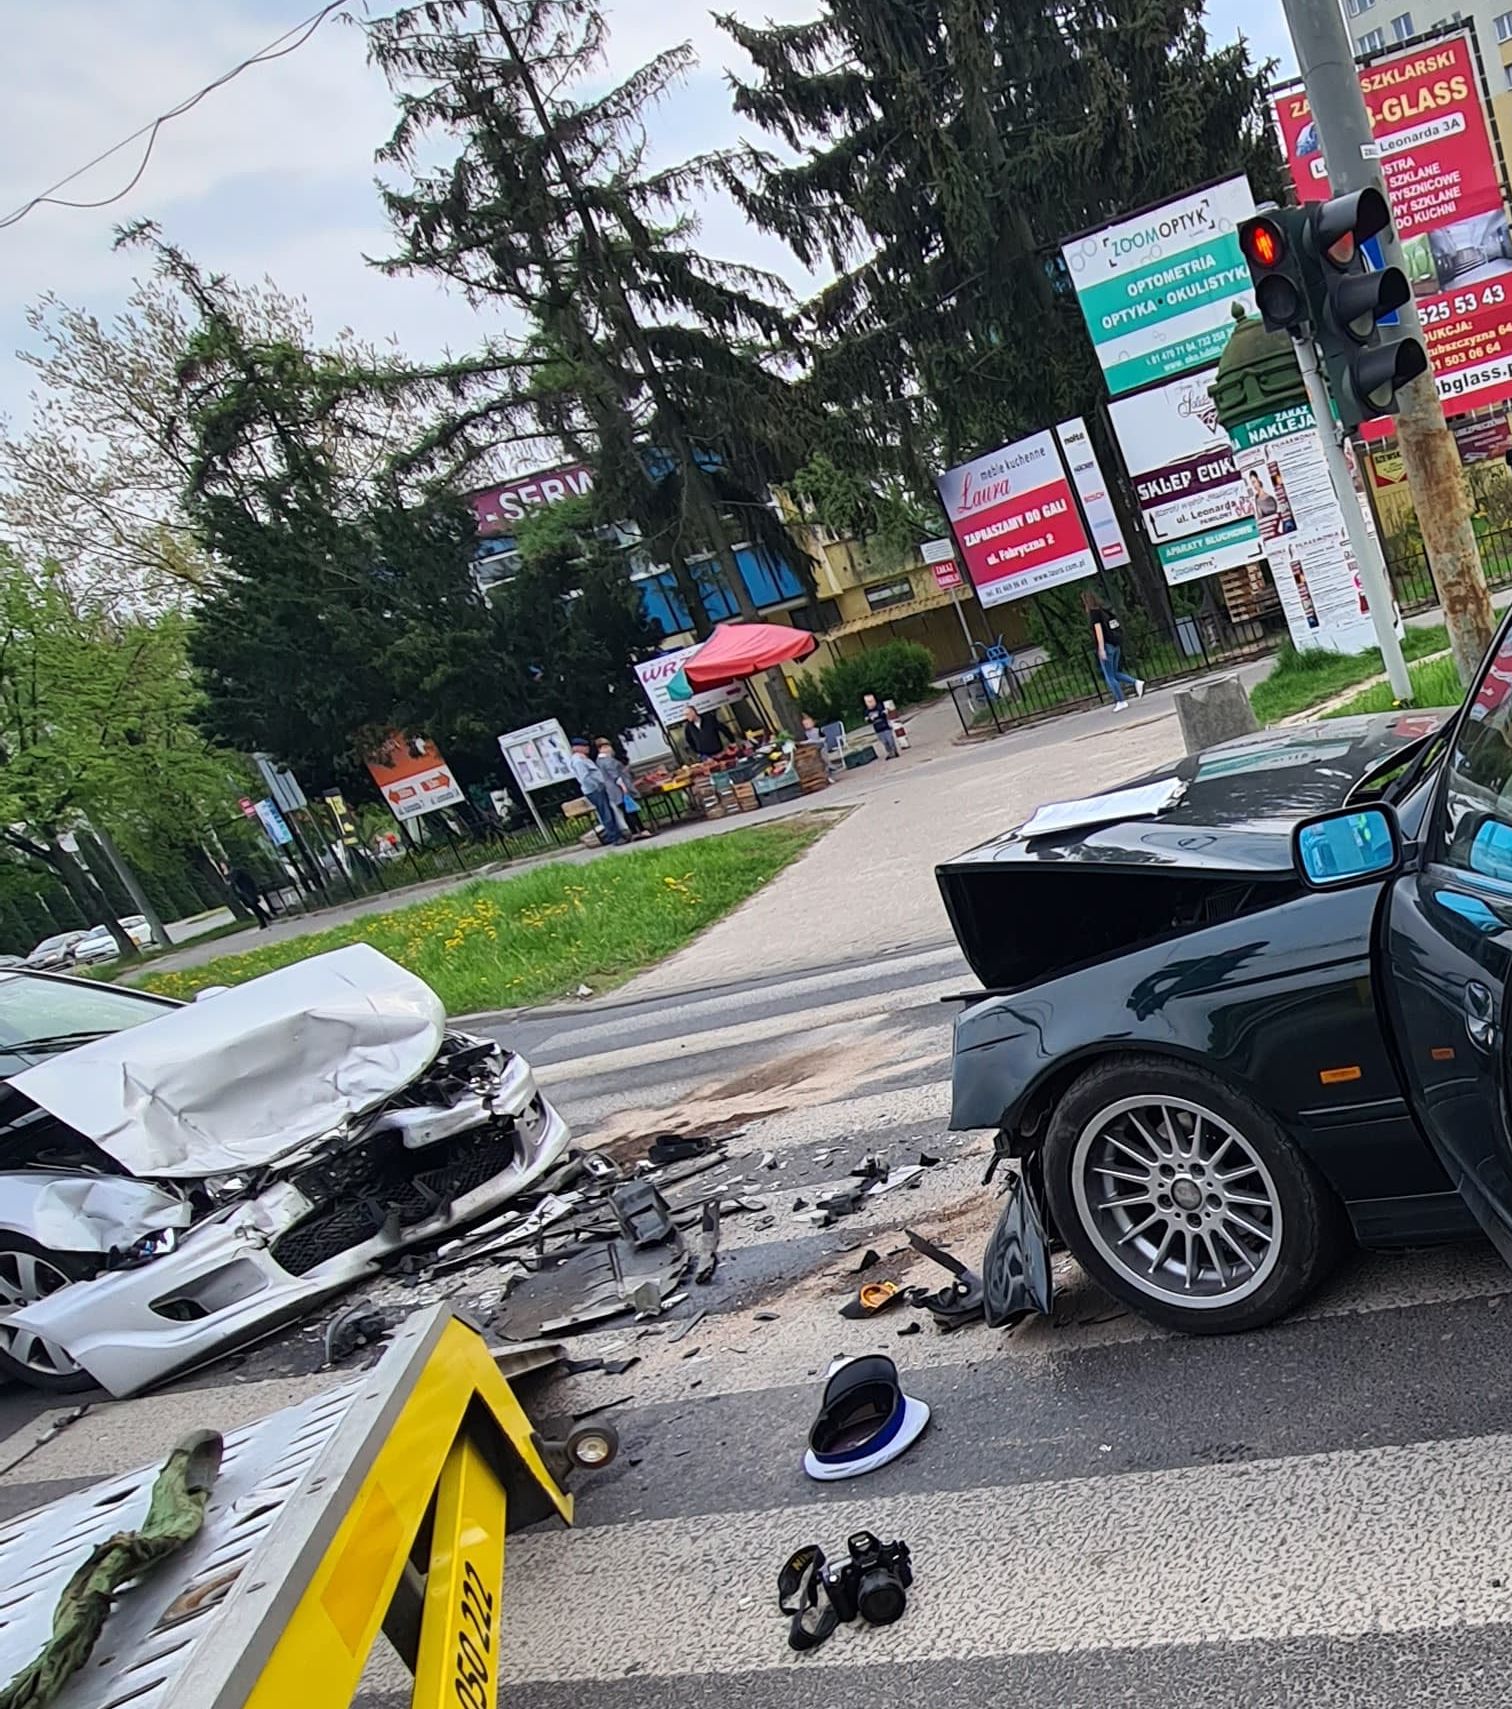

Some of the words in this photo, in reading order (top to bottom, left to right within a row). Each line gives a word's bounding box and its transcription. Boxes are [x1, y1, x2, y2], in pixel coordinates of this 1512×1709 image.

[1360, 50, 1456, 93] SZKLARSKI
[1380, 126, 1440, 152] Leonarda
[1443, 117, 1462, 133] 3A
[1389, 162, 1441, 187] SZKLANE
[1389, 171, 1462, 201] RYSZNICOWE
[1395, 213, 1413, 230] DO
[1413, 201, 1457, 225] KUCHNI
[1409, 186, 1462, 212] SZKLANE
[1112, 206, 1207, 257] ZOOMOPTYK
[1127, 253, 1216, 298] OPTOMETRIA
[1102, 300, 1158, 330] OPTYKA
[1166, 265, 1249, 306] OKULISTYK
[1418, 301, 1450, 326] 525
[1454, 293, 1478, 314] 53
[1482, 284, 1506, 306] 43
[1445, 354, 1466, 369] 503
[1486, 343, 1501, 356] 64
[1248, 414, 1317, 445] NAKLEJA
[1274, 405, 1309, 422] ZAKAZ
[979, 463, 1004, 481] meble
[1004, 446, 1046, 471] kuchenne
[1137, 470, 1192, 501] SKLEP
[1197, 455, 1237, 483] CUK
[956, 471, 1011, 524] Laura
[1176, 515, 1190, 525] ul.
[1190, 499, 1237, 520] Leonarda
[963, 515, 1025, 548] ZAPRASZAMY
[1024, 509, 1041, 526] DO
[986, 554, 1000, 566] ul.
[999, 538, 1046, 559] Fabryczna
[1046, 533, 1055, 545] 2
[642, 660, 678, 683] WR
[461, 1561, 493, 1655] 222
